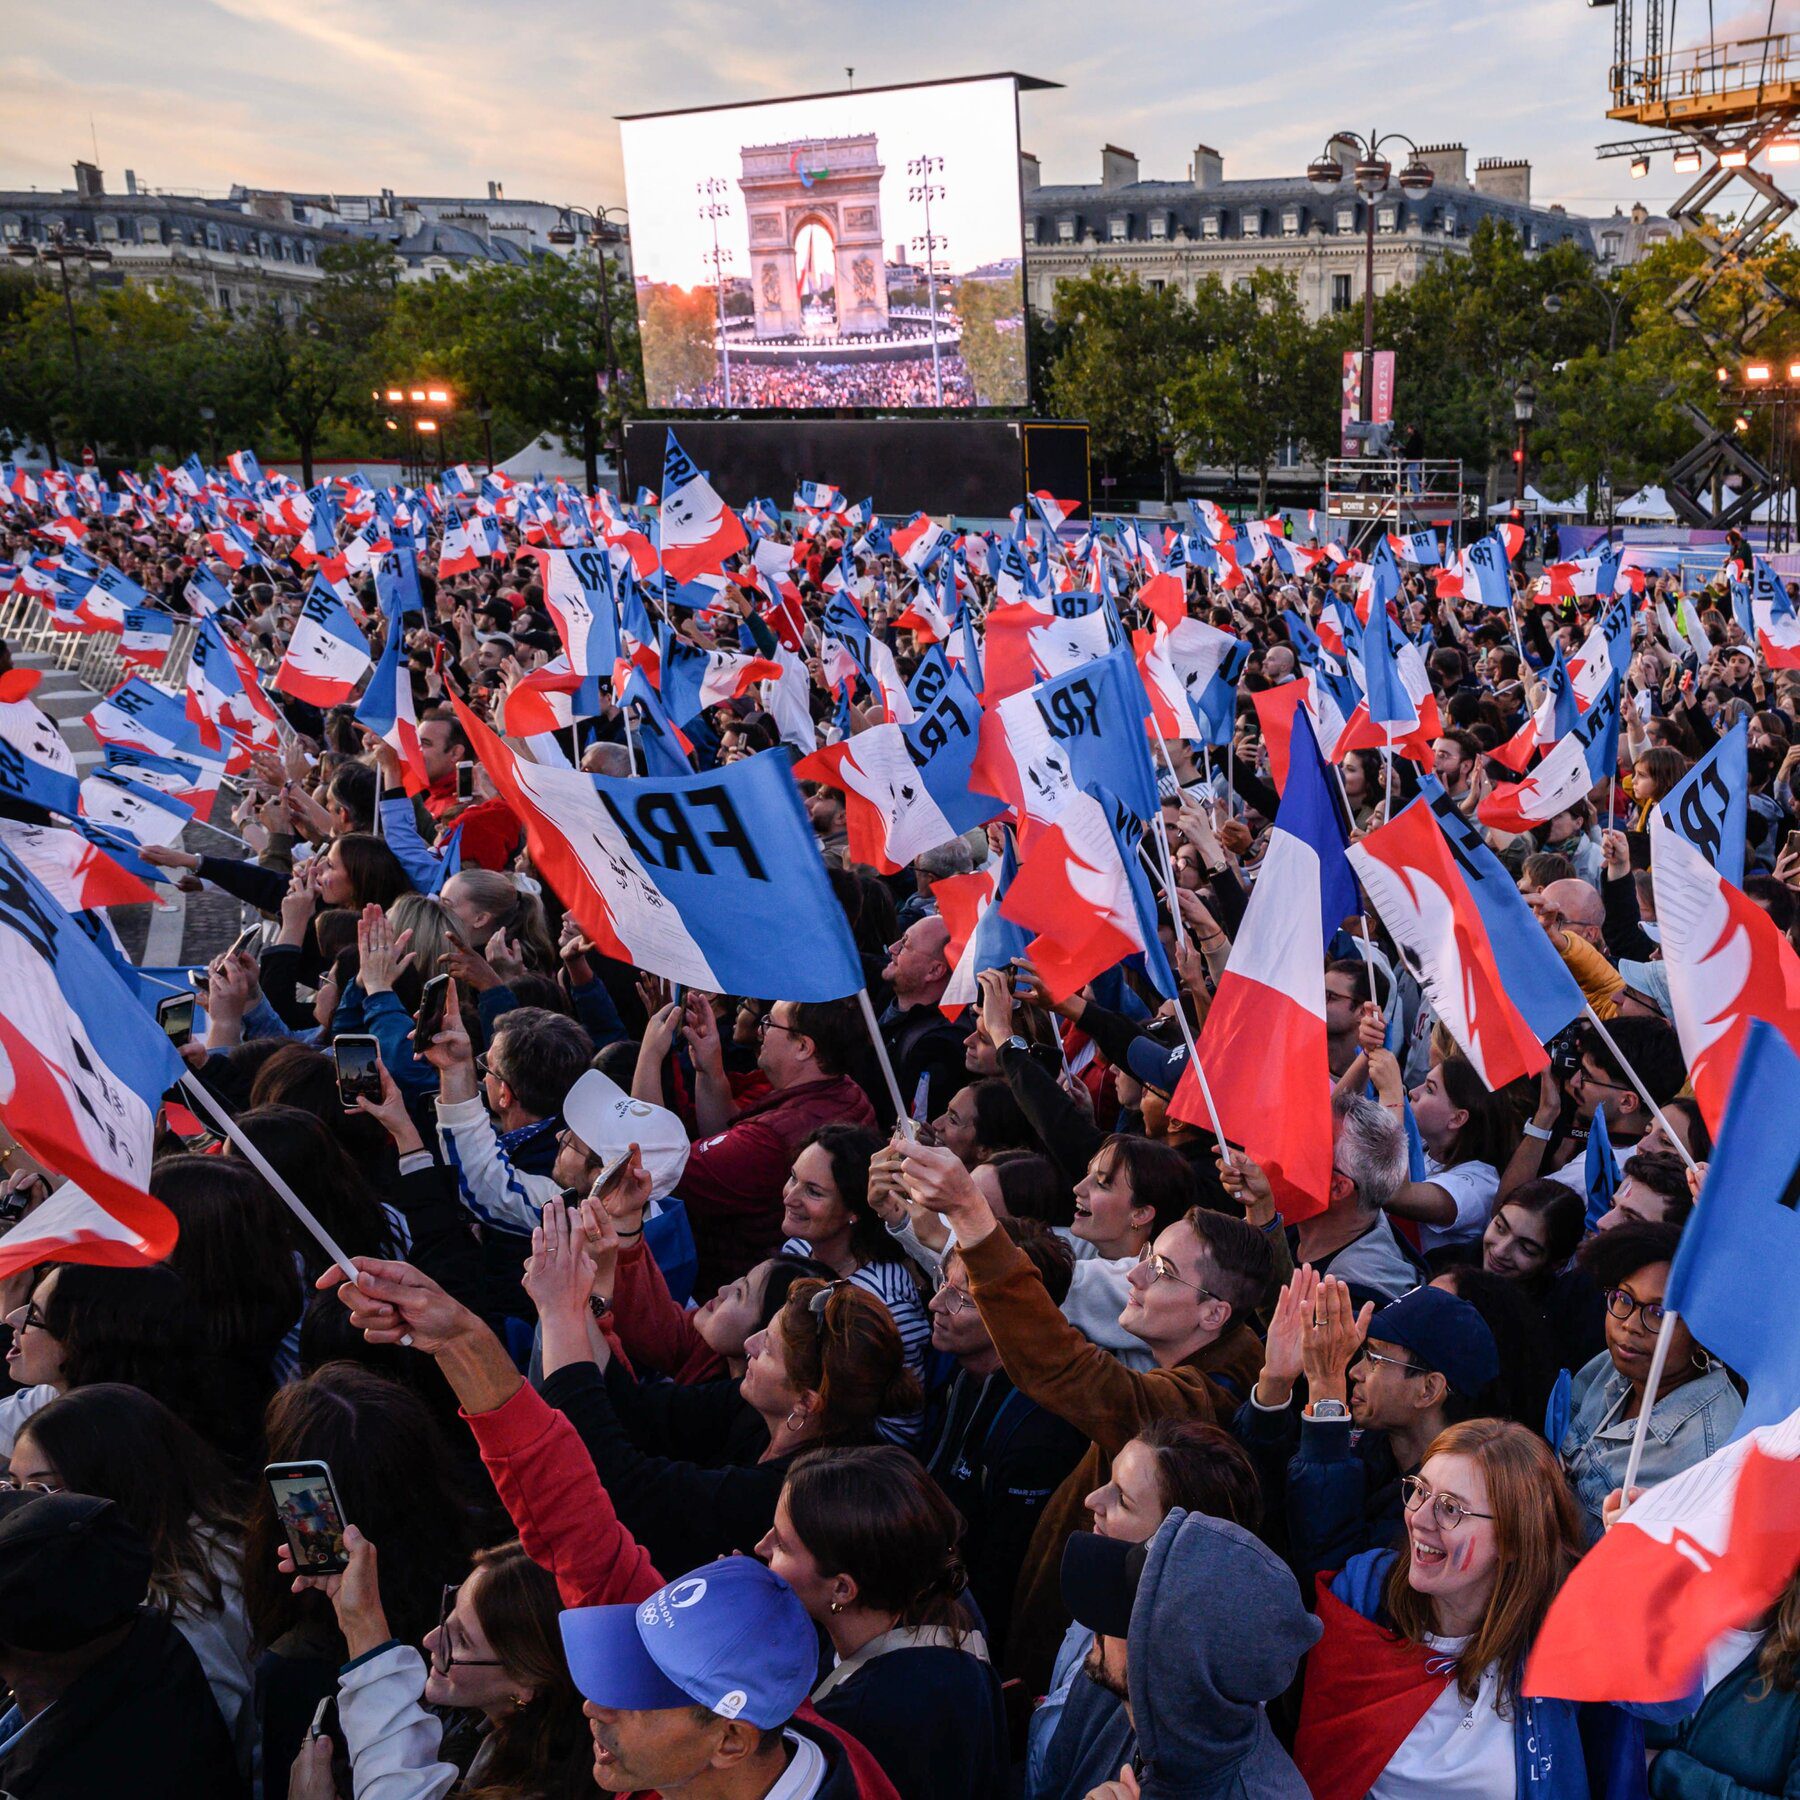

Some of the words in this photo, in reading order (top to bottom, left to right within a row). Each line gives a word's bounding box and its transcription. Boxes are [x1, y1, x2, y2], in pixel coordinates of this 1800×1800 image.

[1380, 361, 1389, 401] 2024
[1342, 502, 1364, 511] SORTIE
[1571, 1129, 1584, 1138] EOS
[660, 1605, 675, 1629] 2024
